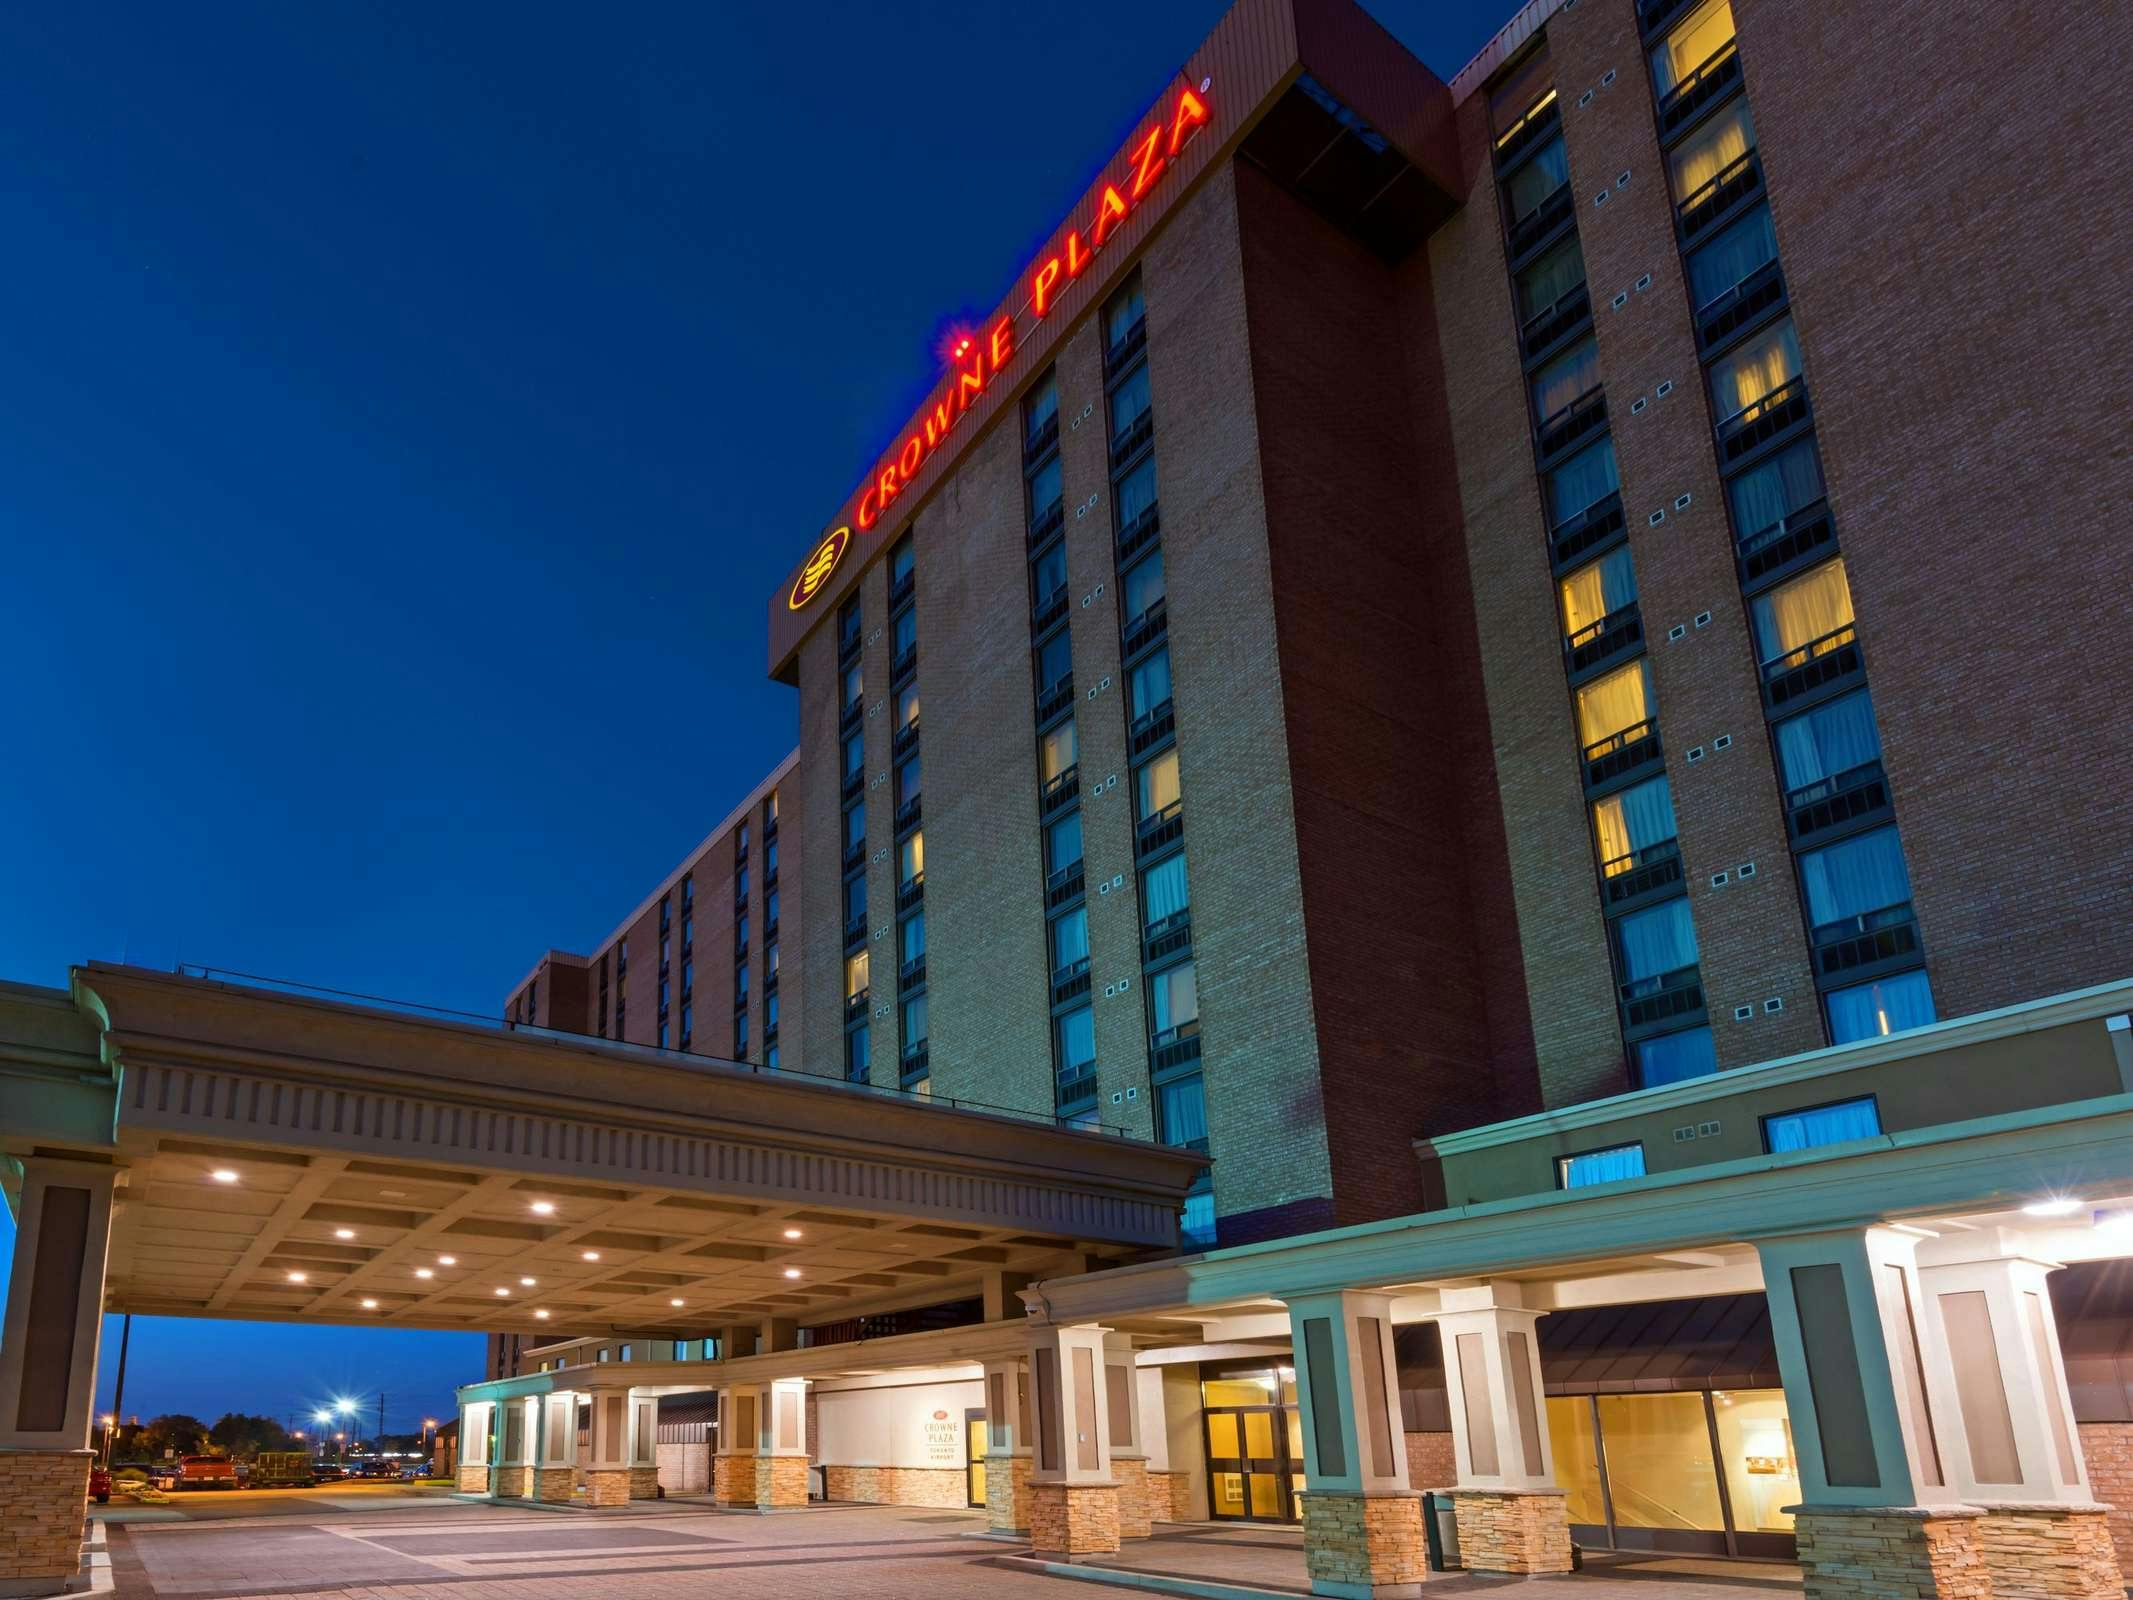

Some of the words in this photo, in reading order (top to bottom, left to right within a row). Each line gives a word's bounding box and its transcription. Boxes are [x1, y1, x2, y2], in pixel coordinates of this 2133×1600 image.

[855, 315, 1015, 529] CROWNE
[1034, 89, 1210, 317] PLAZA
[924, 1422, 959, 1433] CROWNE
[928, 1433, 954, 1443] PLAZA
